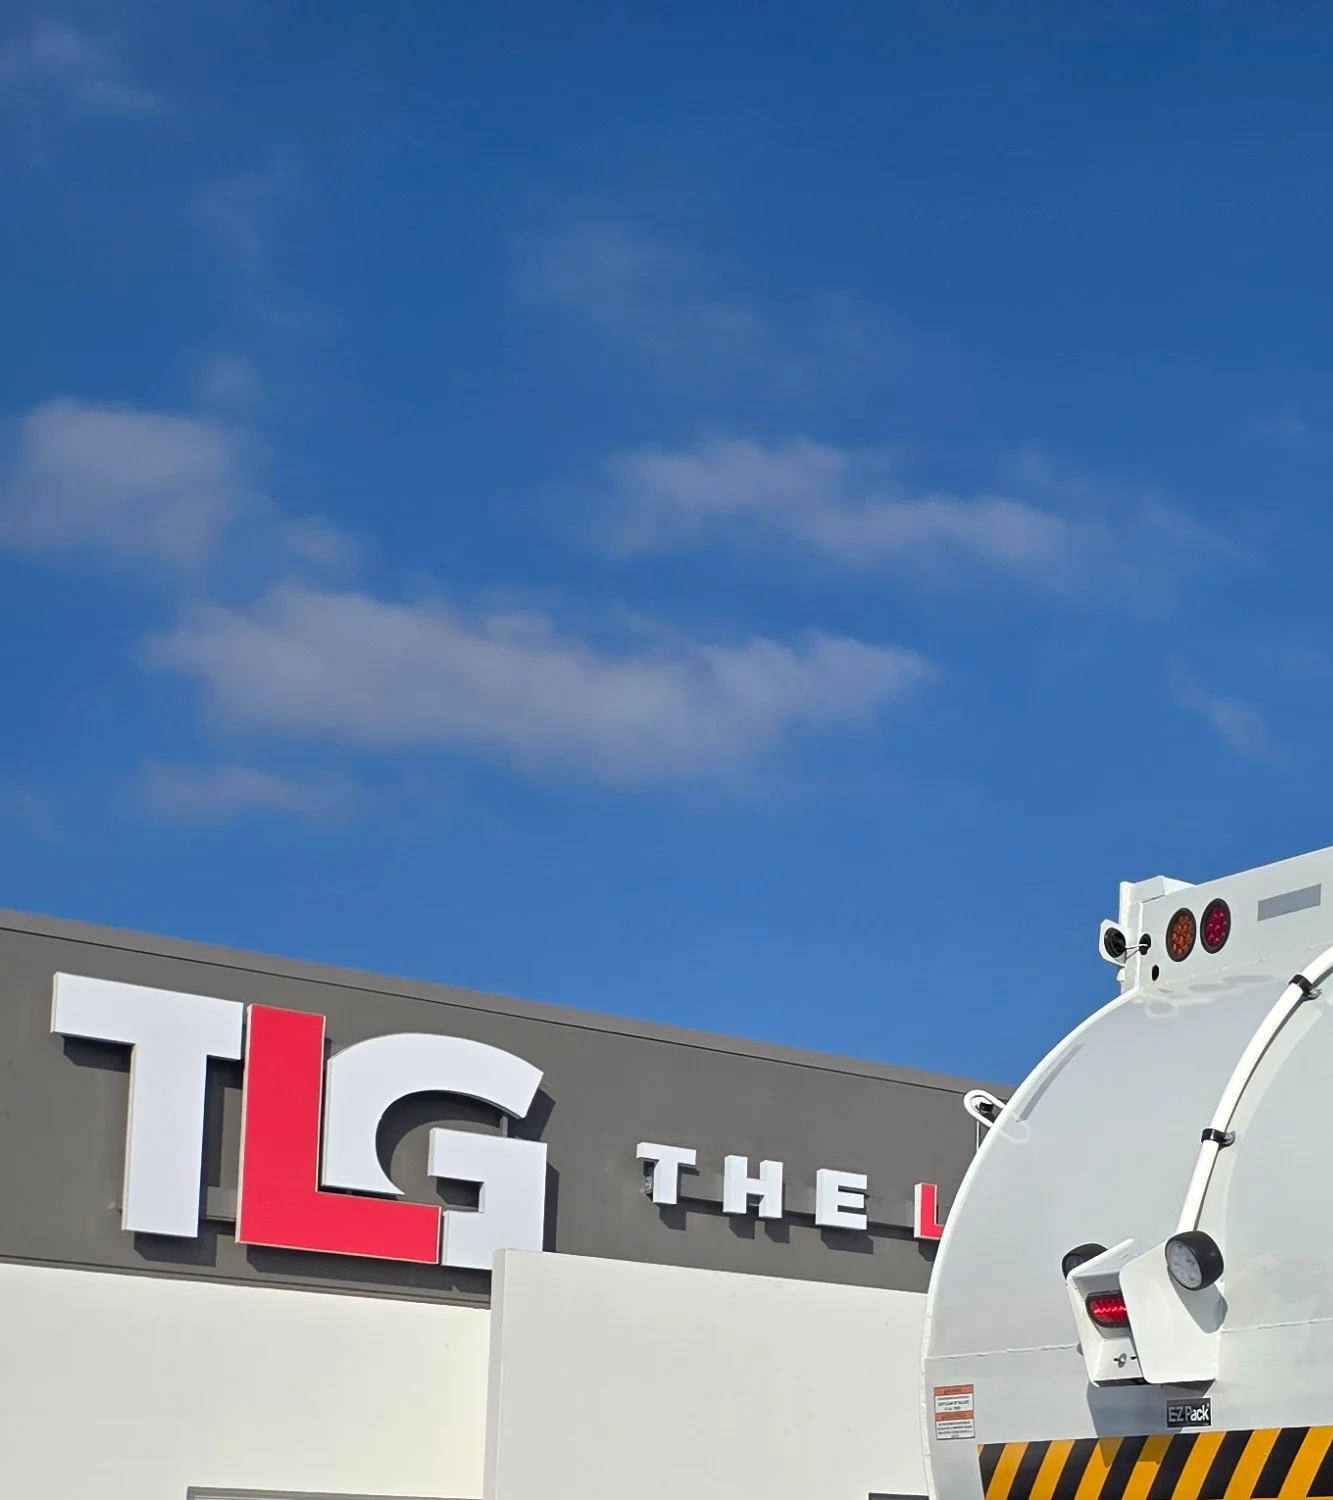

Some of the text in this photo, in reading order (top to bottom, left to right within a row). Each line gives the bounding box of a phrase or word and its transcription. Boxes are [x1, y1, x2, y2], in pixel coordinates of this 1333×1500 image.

[50, 972, 548, 1271] TLG
[636, 1141, 868, 1230] THE
[1184, 1404, 1209, 1421] Pack
